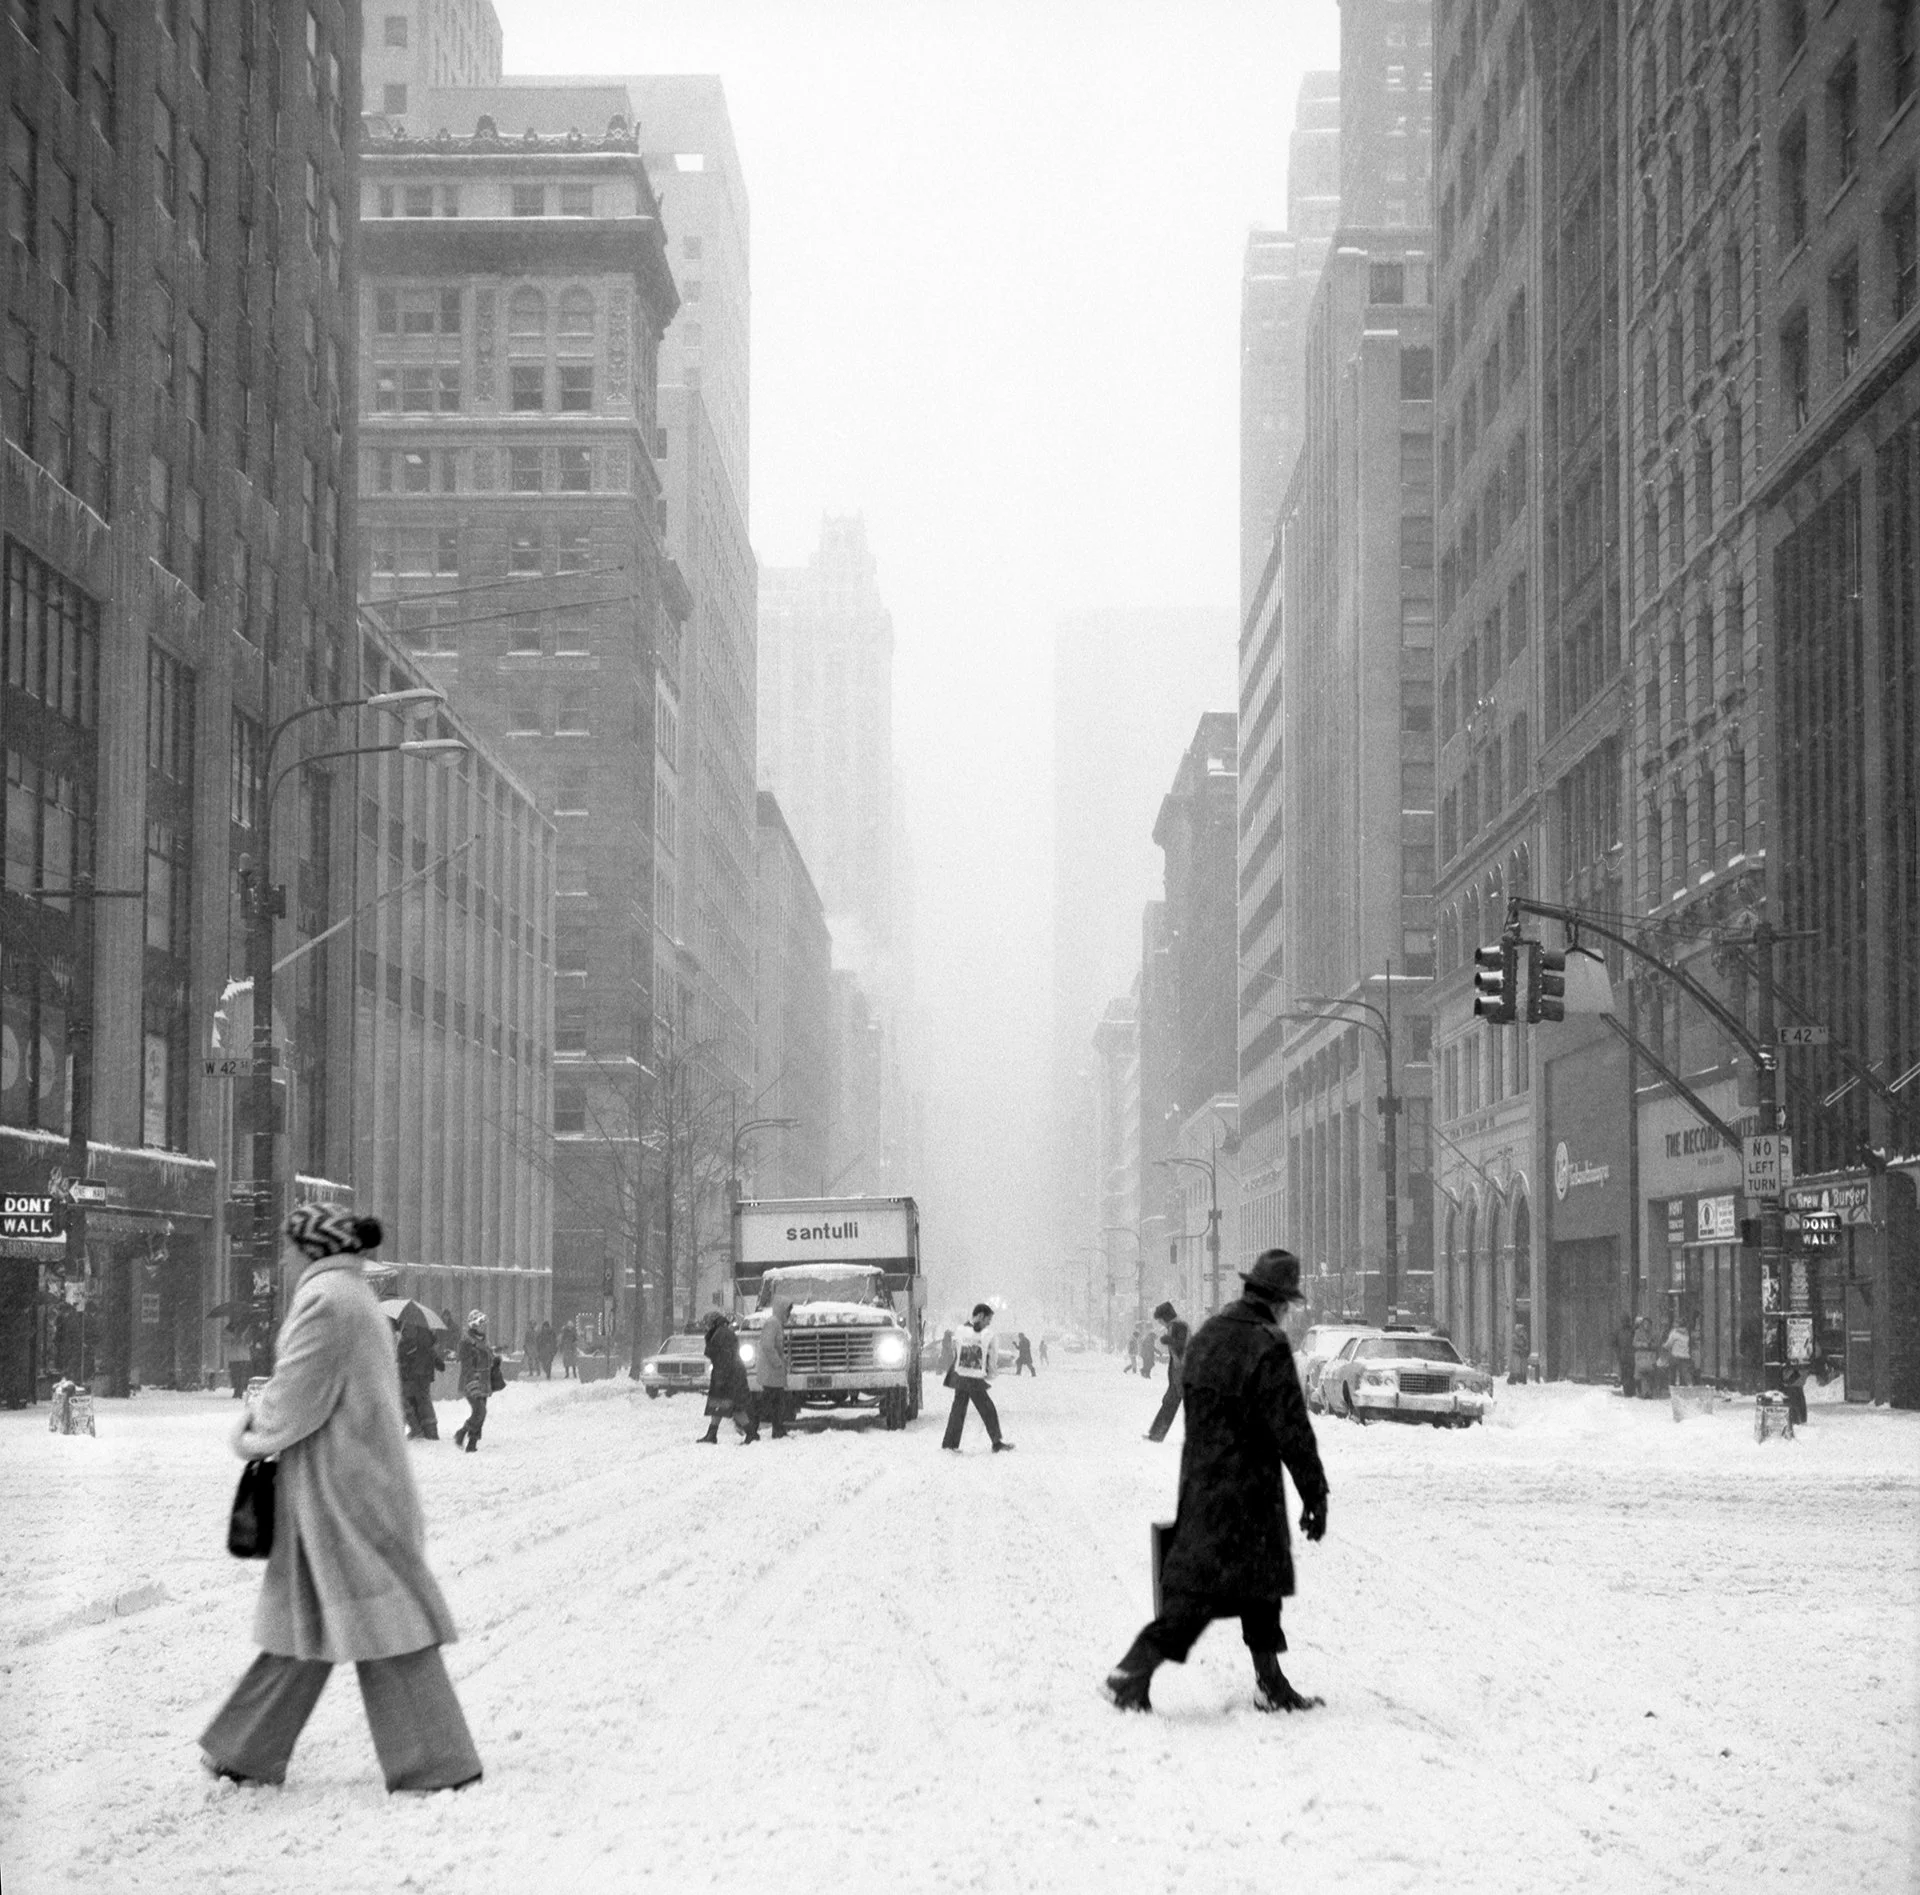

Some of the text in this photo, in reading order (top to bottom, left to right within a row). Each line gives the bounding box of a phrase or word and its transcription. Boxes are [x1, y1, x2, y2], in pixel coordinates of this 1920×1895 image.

[1781, 1028, 1812, 1043] E 42
[205, 1061, 215, 1075] W
[220, 1060, 236, 1075] 42
[1665, 1131, 1681, 1159] THE
[1683, 1125, 1720, 1155] RECORD
[1752, 1141, 1771, 1156] NO
[1749, 1161, 1774, 1174] LEFT
[1748, 1178, 1776, 1191] TURN
[4, 1197, 52, 1213] DONT
[1832, 1187, 1866, 1208] Burger
[4, 1218, 52, 1233] WALK
[786, 1221, 859, 1241] santulli
[1802, 1218, 1836, 1230] DONT
[1803, 1233, 1837, 1245] WALK
